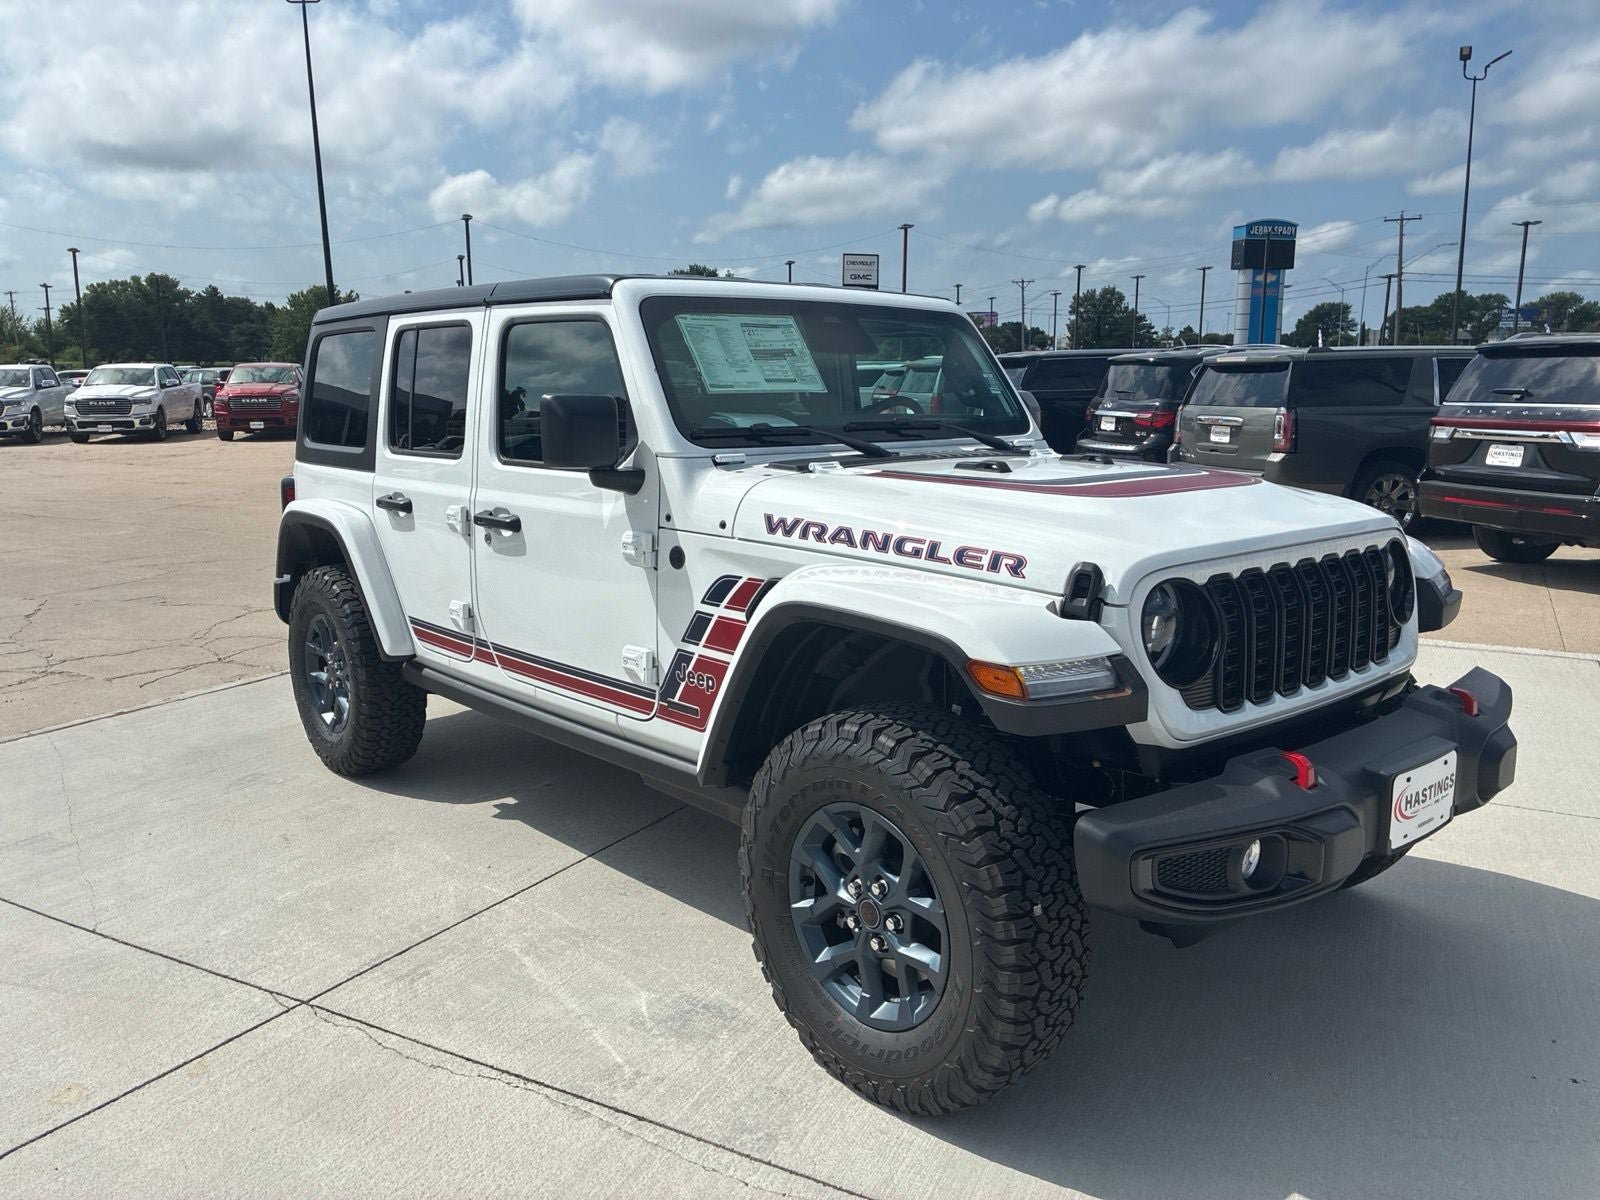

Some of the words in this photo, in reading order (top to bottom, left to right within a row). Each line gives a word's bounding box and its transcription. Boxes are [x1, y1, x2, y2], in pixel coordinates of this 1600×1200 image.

[1493, 450, 1522, 458] HASTINGS
[763, 512, 1028, 579] WRANGLER
[675, 662, 716, 694] Jeep
[1405, 772, 1455, 811] HASTINGS
